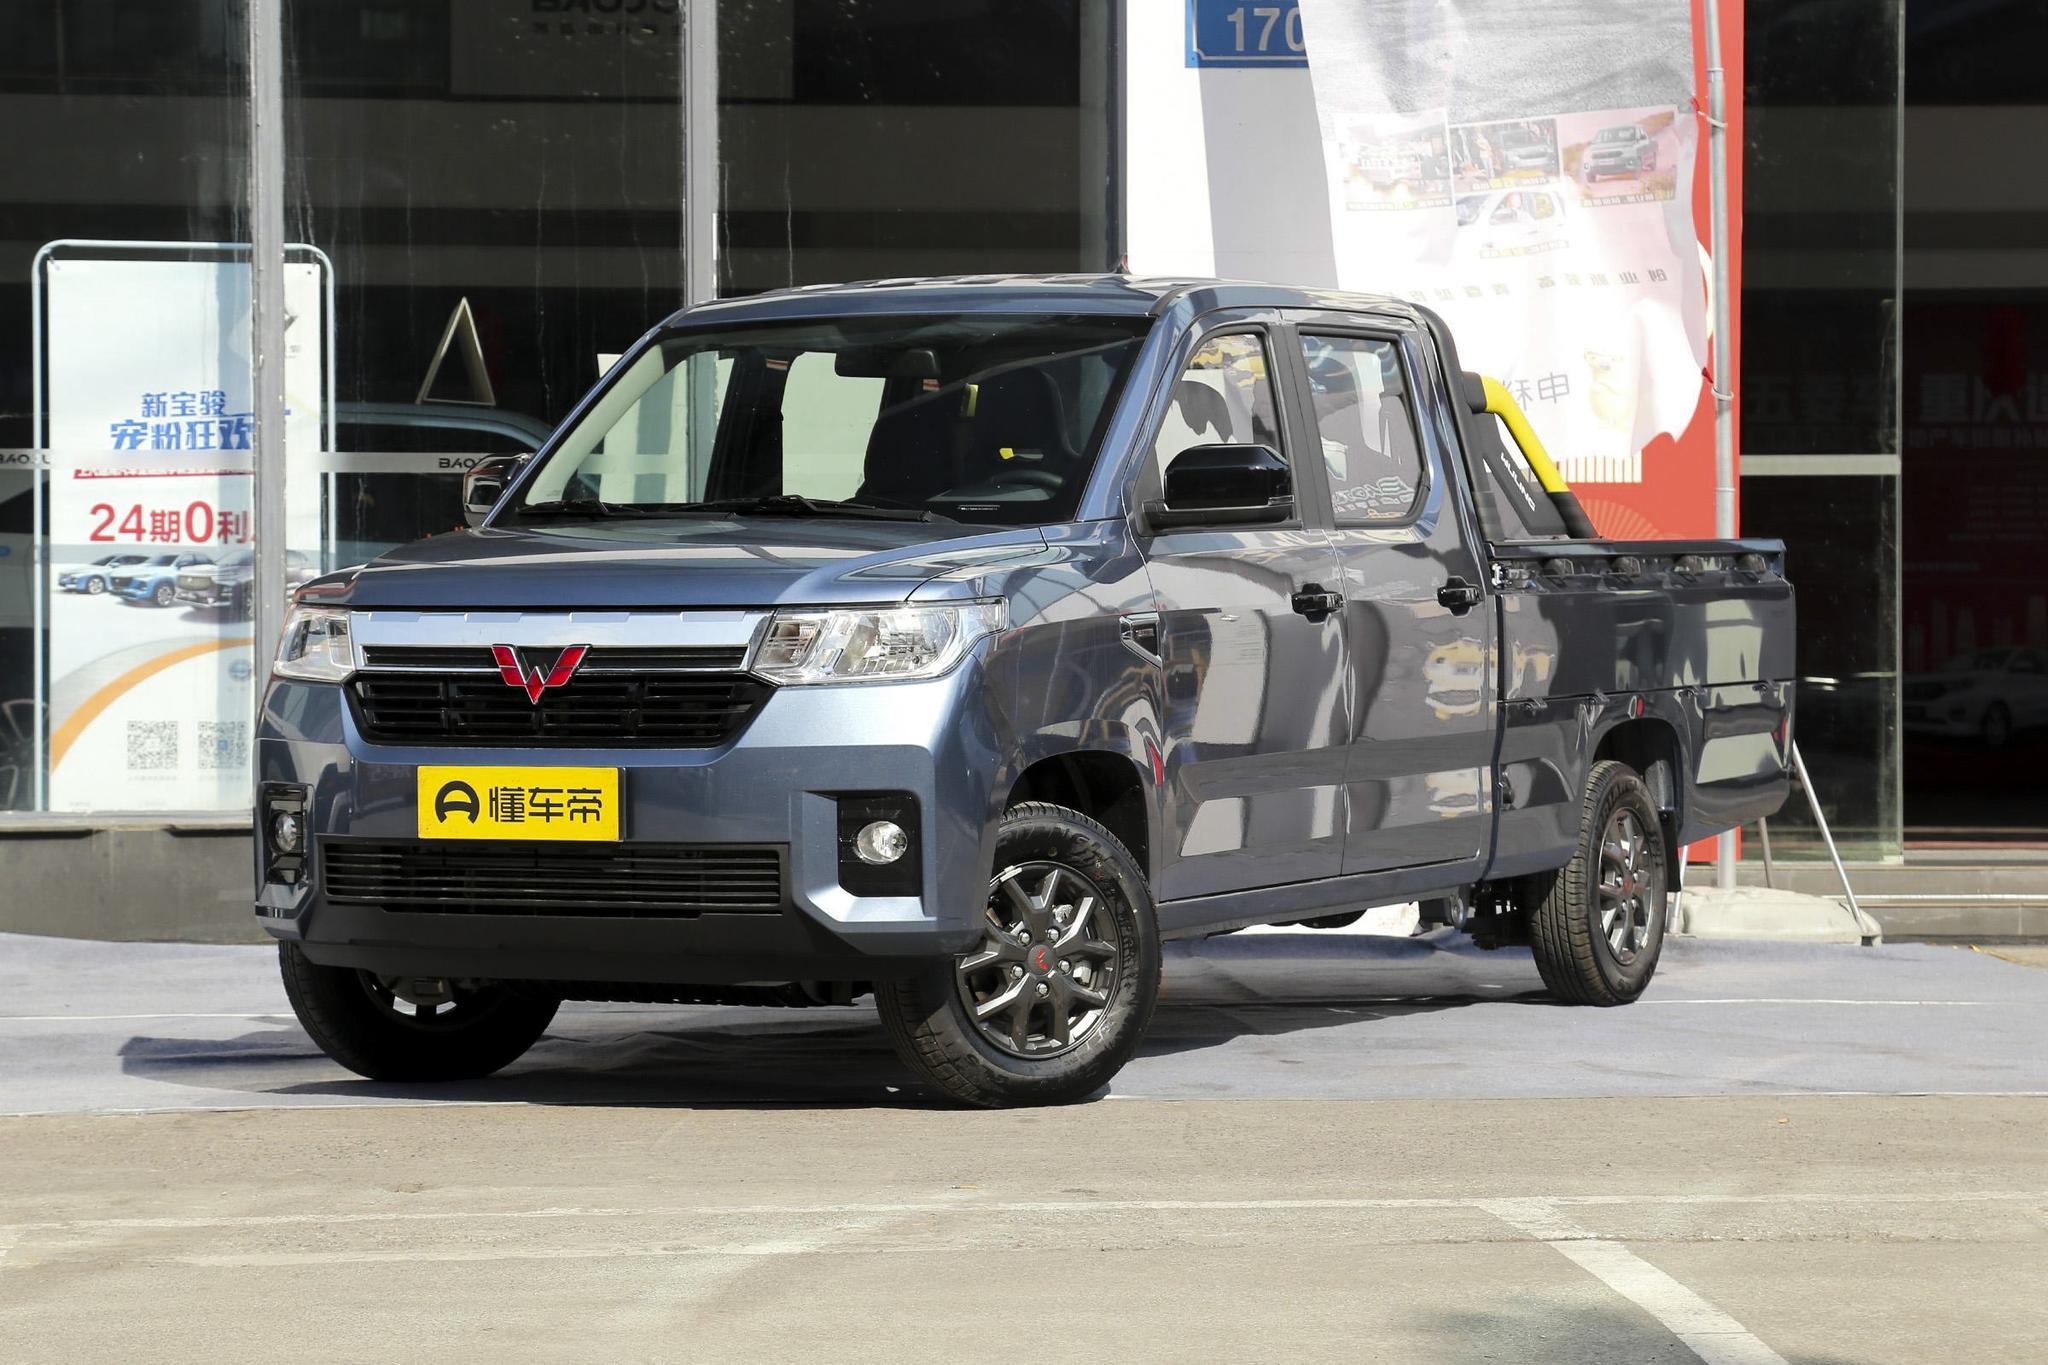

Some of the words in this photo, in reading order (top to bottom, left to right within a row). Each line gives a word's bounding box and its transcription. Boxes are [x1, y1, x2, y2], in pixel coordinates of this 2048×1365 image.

[1227, 7, 1306, 52] 170
[142, 389, 226, 418] 新宝骏
[110, 418, 256, 450] 宠粉狂欢
[439, 457, 478, 468] BAO
[1500, 451, 1536, 512] WULING
[90, 500, 256, 544] 24期0利
[489, 786, 602, 823] 懂车帝
